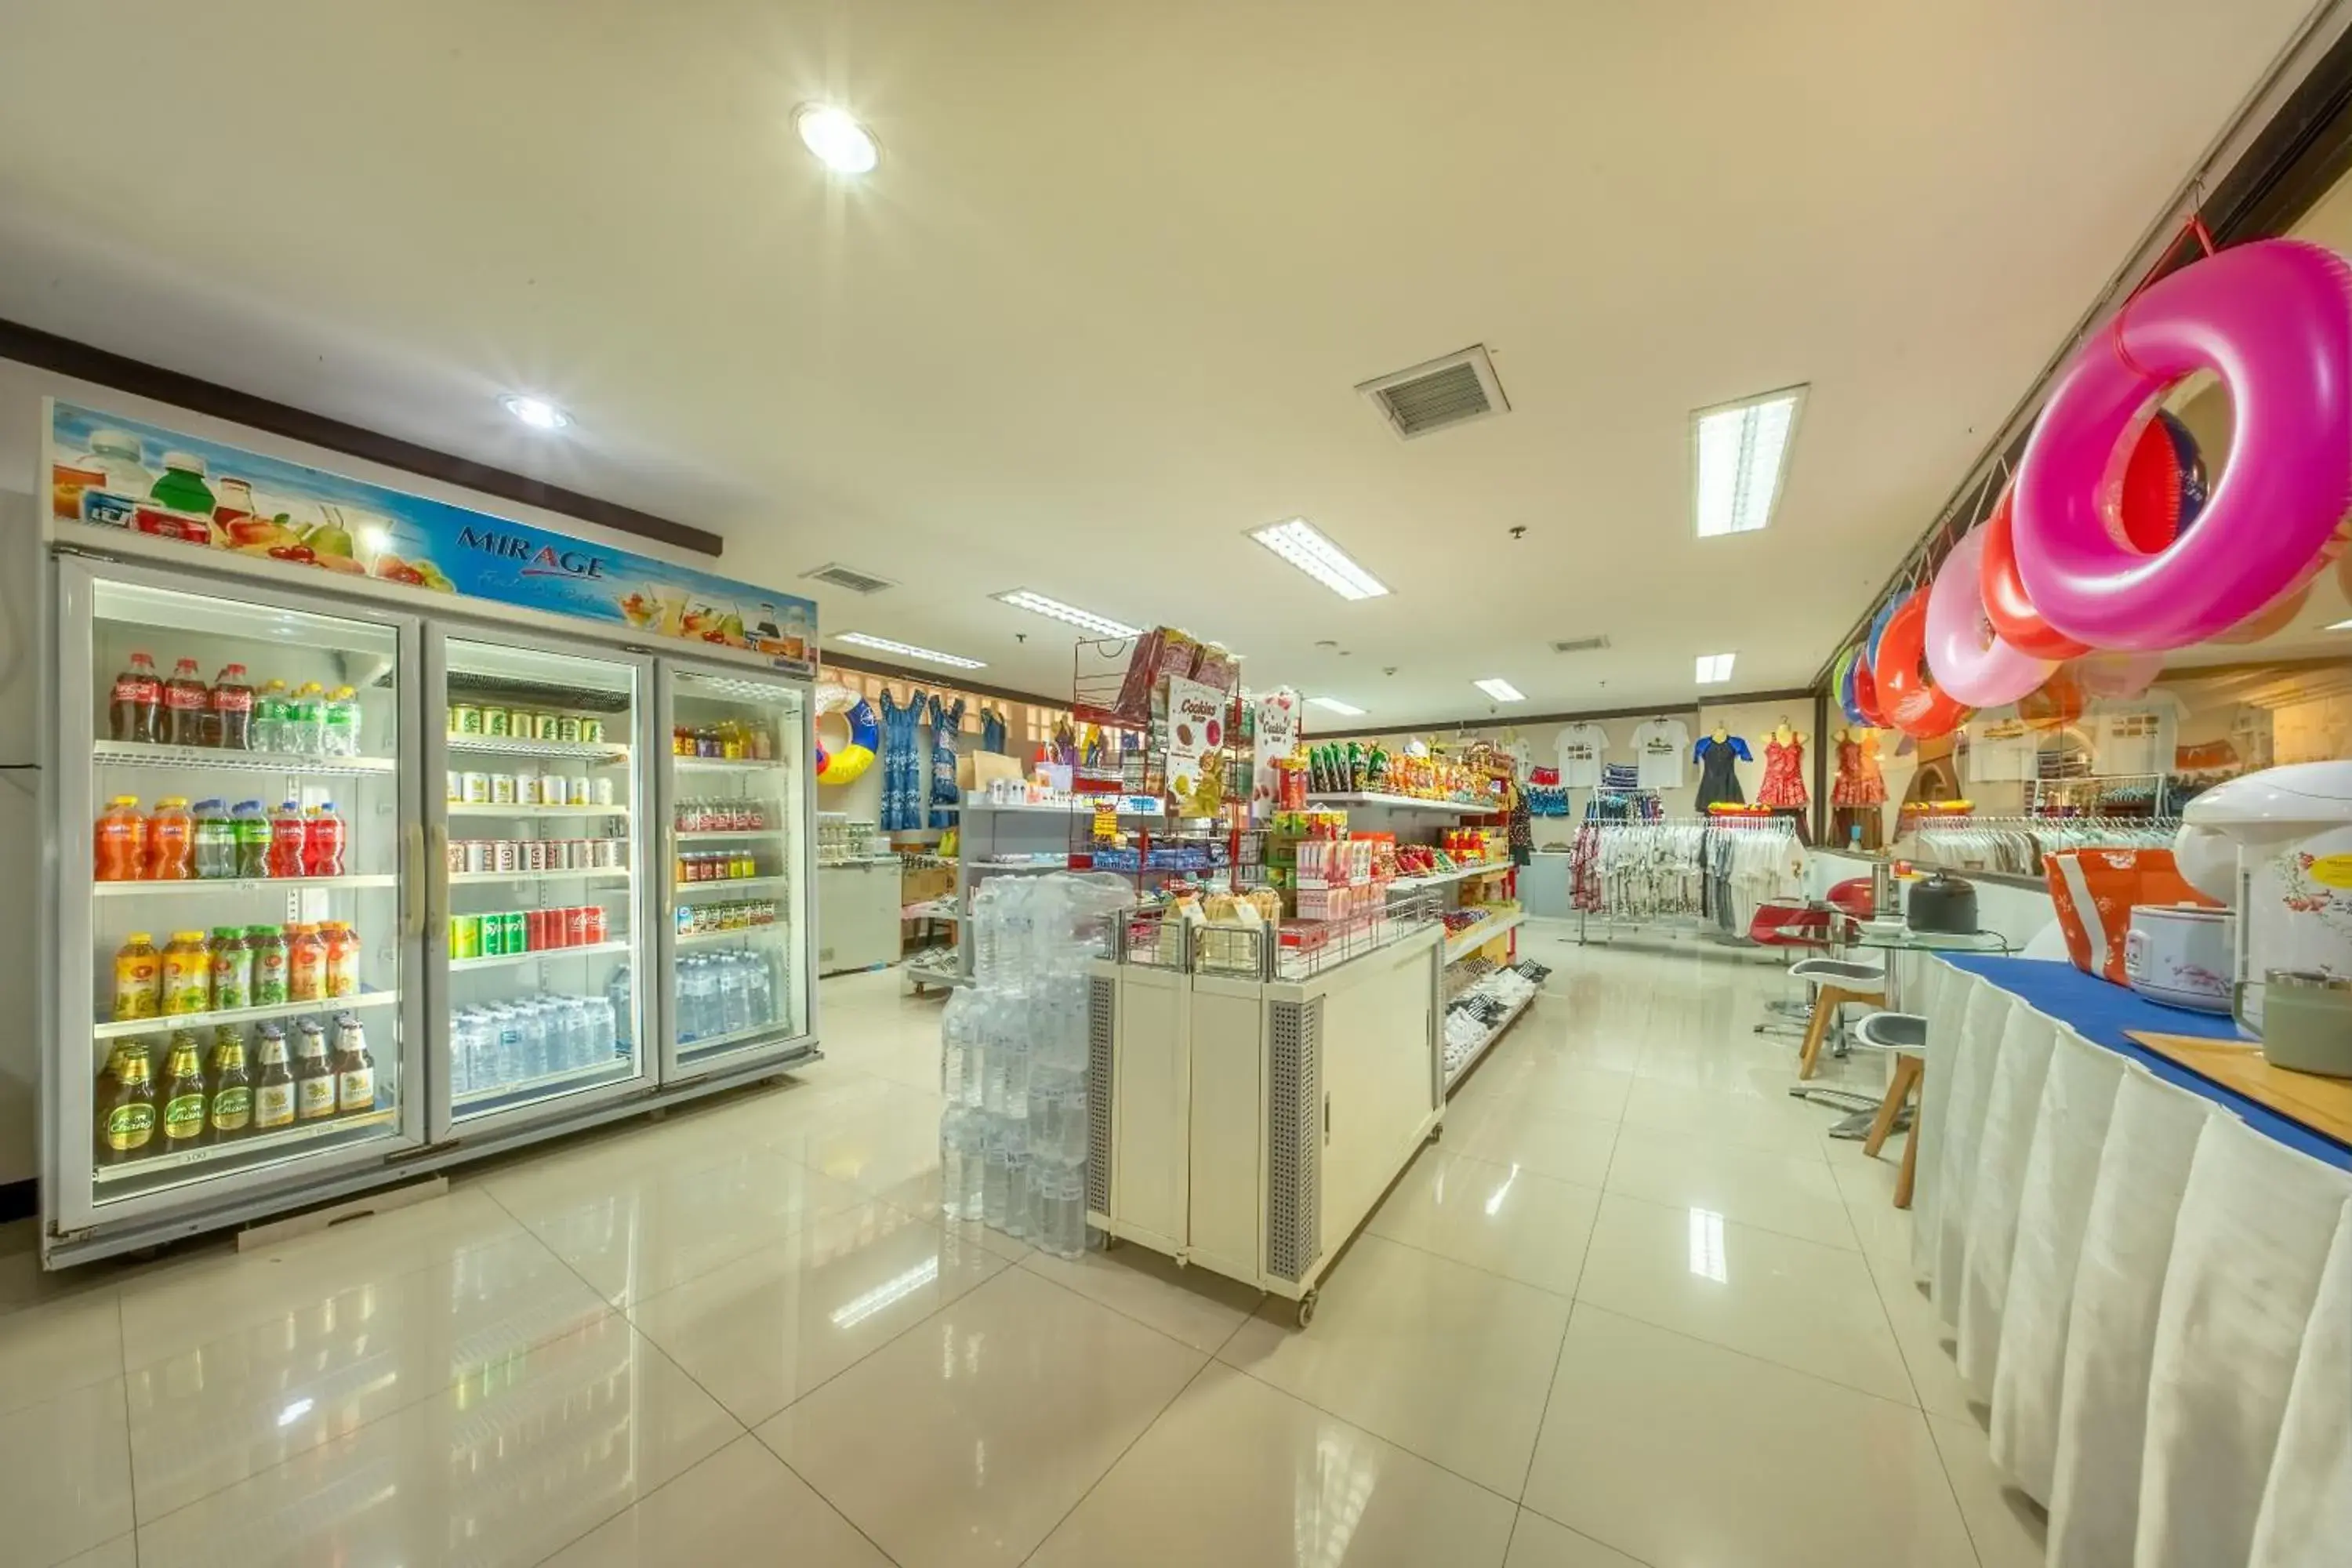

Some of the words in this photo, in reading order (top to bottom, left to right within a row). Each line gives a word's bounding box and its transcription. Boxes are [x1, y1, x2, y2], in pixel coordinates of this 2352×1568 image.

[456, 526, 604, 578] MIRAGE
[502, 850, 512, 868] LEO
[532, 851, 541, 868] LEO
